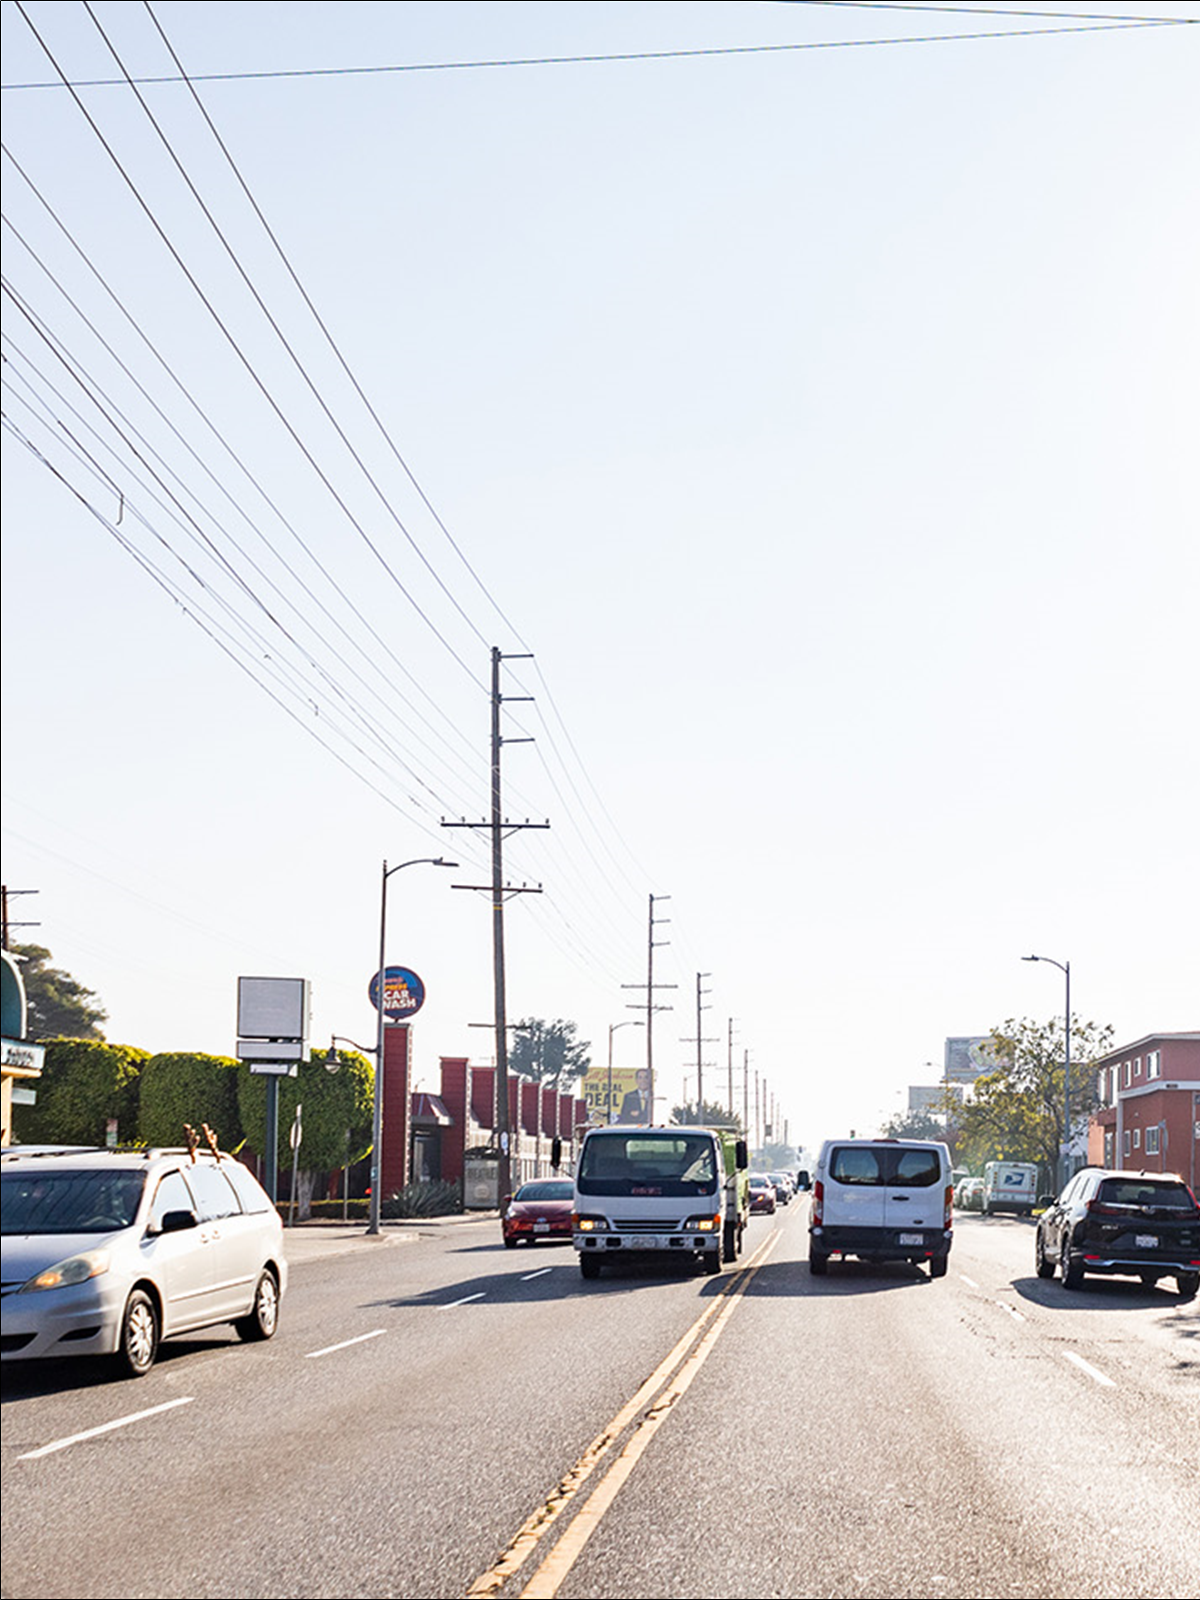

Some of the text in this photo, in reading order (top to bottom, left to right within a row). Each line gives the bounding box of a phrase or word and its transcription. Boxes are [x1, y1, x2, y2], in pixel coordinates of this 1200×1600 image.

[384, 989, 409, 999] CAR
[602, 1083, 622, 1092] RAL
[585, 1093, 619, 1107] DEAL
